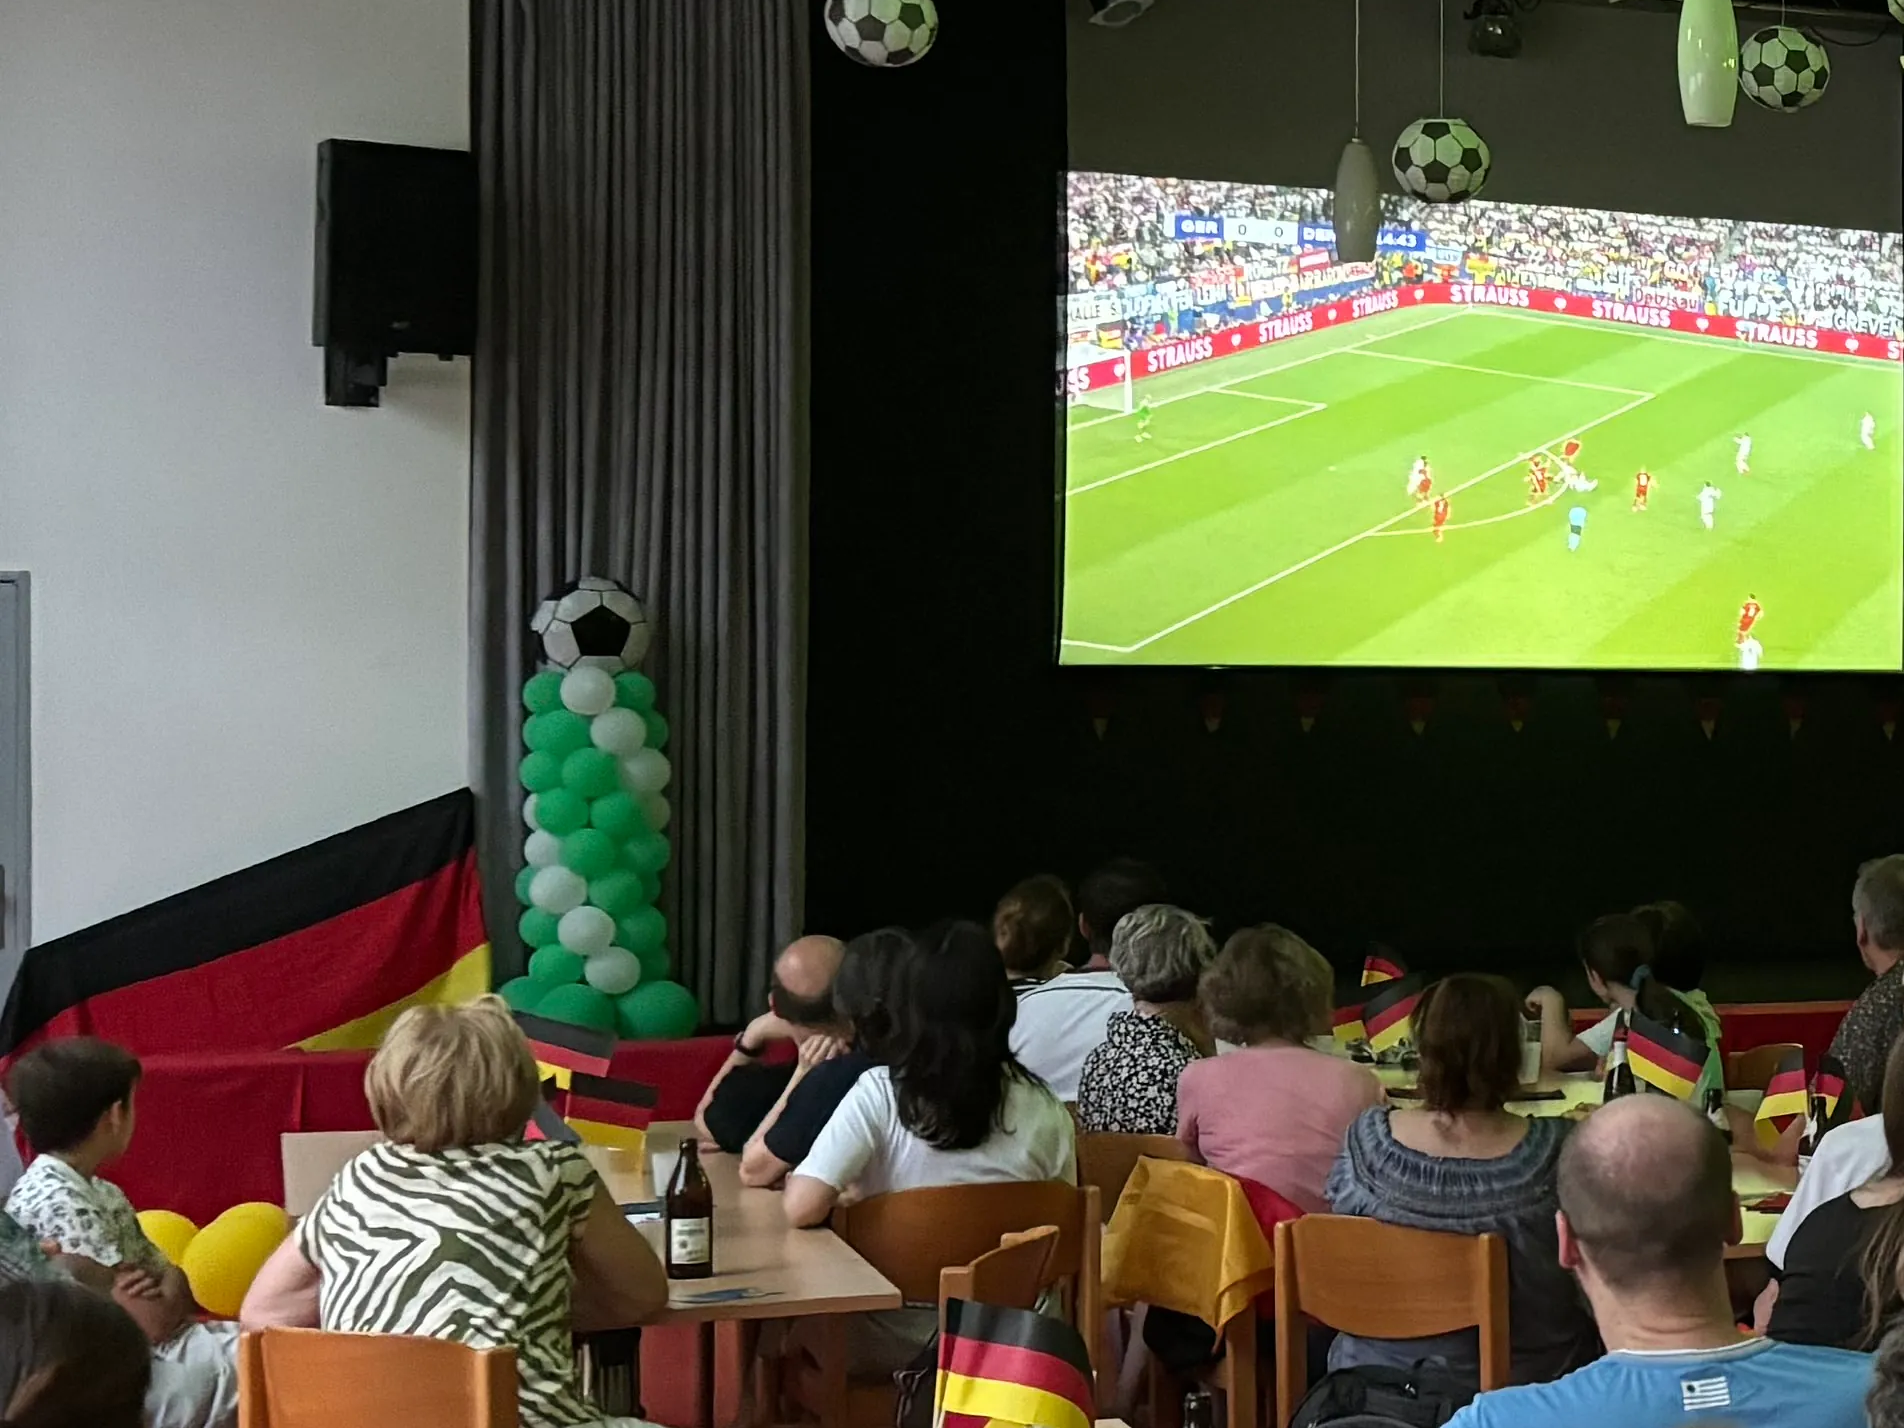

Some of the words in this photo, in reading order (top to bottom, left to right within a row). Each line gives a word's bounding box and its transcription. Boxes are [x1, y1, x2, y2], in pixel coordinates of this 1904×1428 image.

[1181, 219, 1219, 235] GER
[1237, 223, 1247, 236] 0
[1274, 226, 1284, 238] 0
[1352, 290, 1399, 318] STRAUSS
[1450, 283, 1530, 307] STRAUSS
[1259, 310, 1313, 343] STRAUSS
[1592, 300, 1671, 328] STRAUSS
[1735, 320, 1819, 349] STRAUSS
[1147, 335, 1213, 373] STRAUSS
